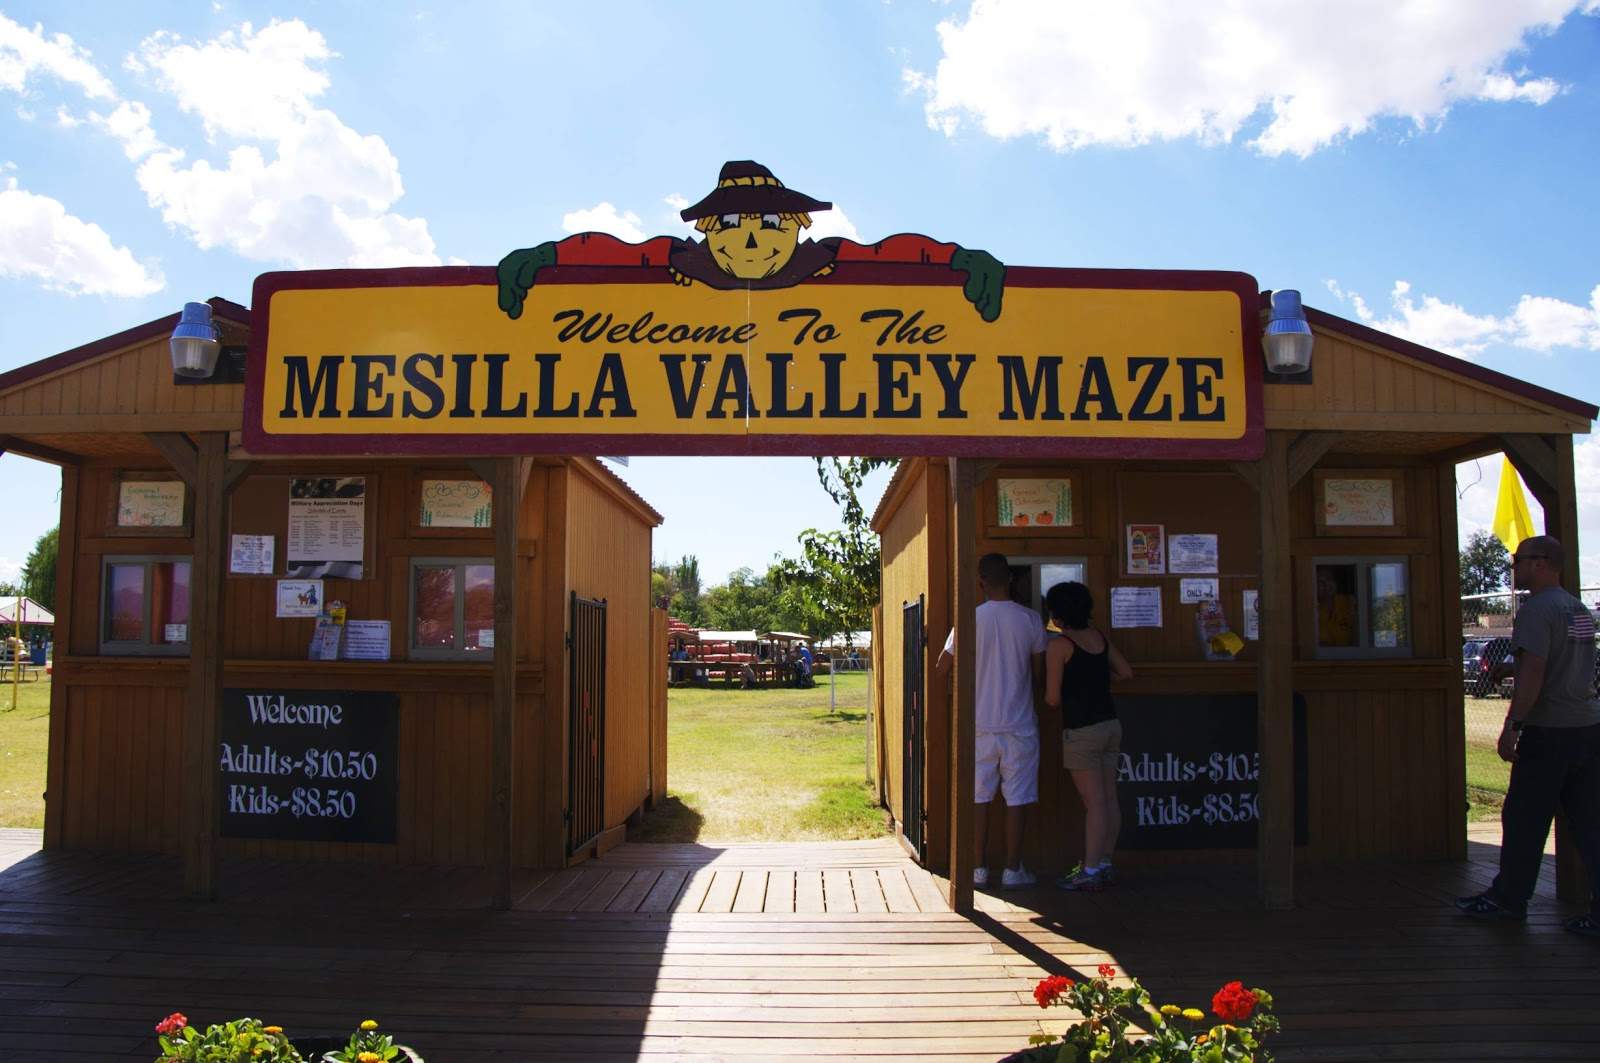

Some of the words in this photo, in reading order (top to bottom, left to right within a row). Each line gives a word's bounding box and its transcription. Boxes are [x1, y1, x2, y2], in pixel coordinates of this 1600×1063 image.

[553, 309, 759, 344] Welcome
[777, 308, 841, 346] To
[860, 309, 947, 346] The
[280, 353, 637, 419] MESILLA
[659, 353, 976, 419] VALLEY
[997, 355, 1226, 422] MAZE
[245, 694, 343, 729] Welcome
[220, 743, 377, 780] Adults-$10.50
[228, 784, 356, 820] Kids-$8.50
